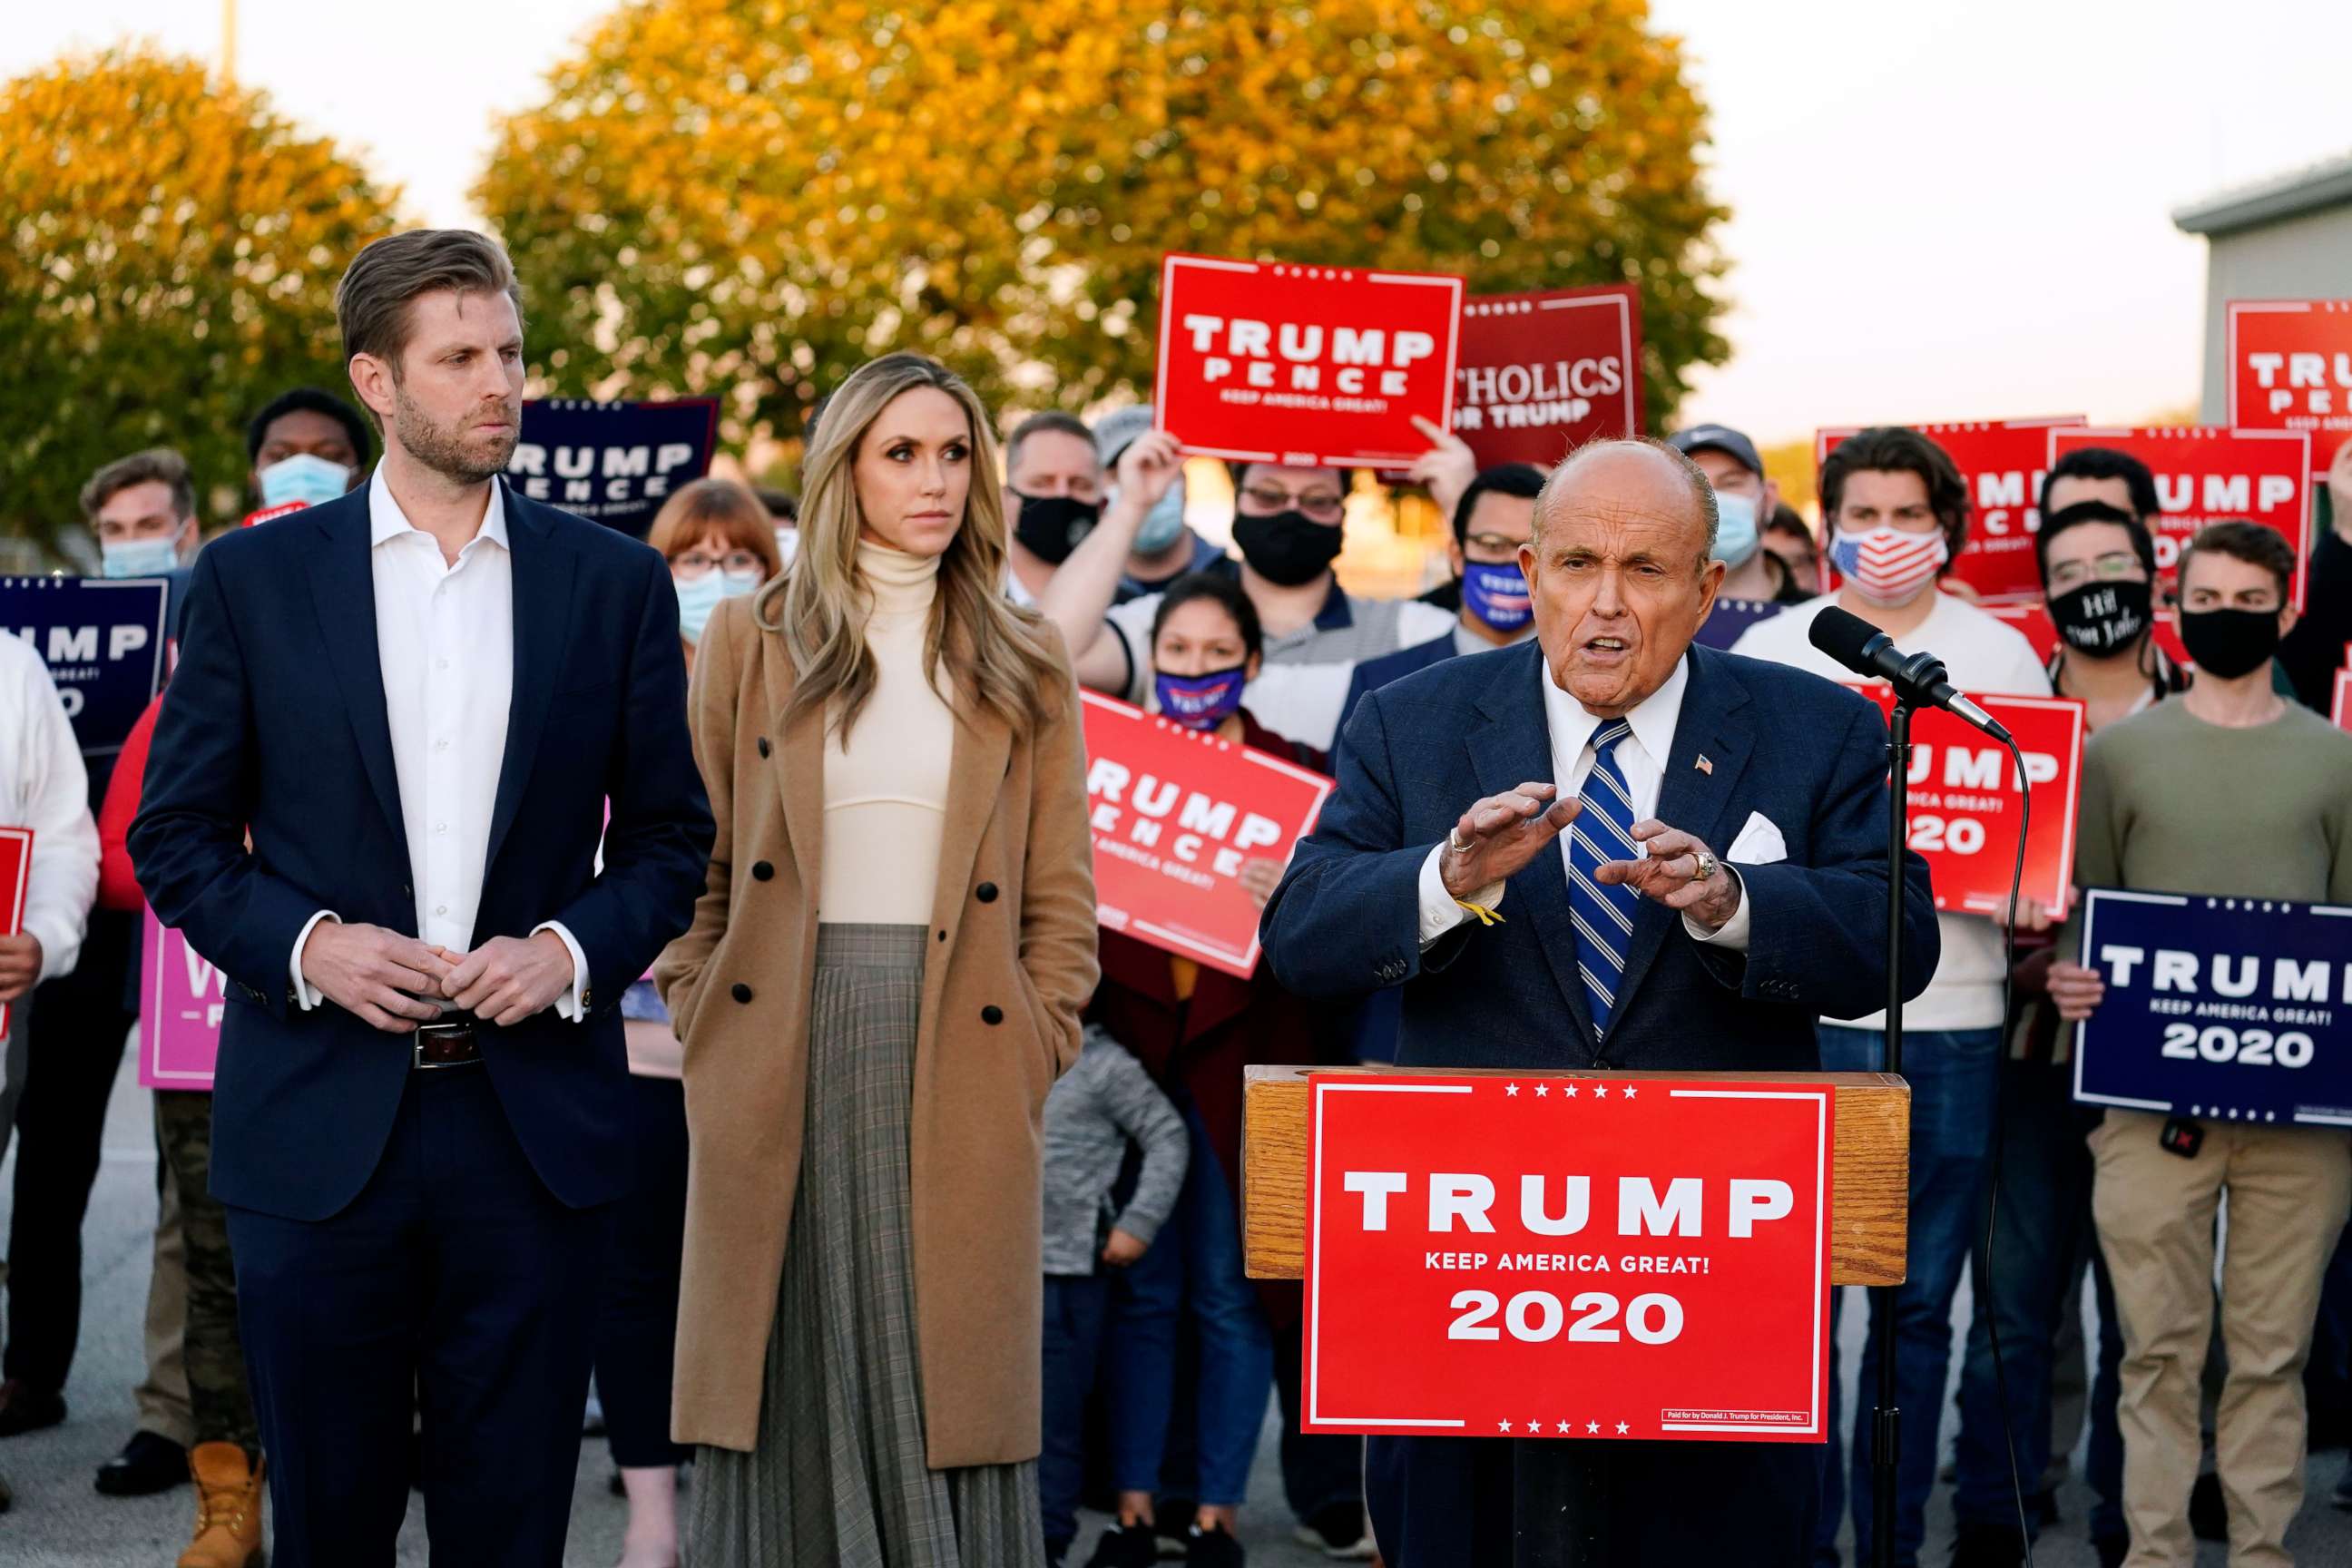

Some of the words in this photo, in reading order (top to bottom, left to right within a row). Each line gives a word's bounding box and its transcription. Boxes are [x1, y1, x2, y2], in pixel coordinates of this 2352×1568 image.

[1183, 314, 1435, 368] TRUMP
[1203, 358, 1407, 397] PENCE
[1488, 398, 1592, 429] TRUMP
[2269, 389, 2352, 415] PE
[502, 473, 670, 502] ENCE
[2153, 474, 2296, 513] UMP
[1087, 757, 1282, 849] RUMP
[1906, 815, 1985, 855] 20
[2101, 944, 2352, 1004] TRUM
[2149, 997, 2192, 1014] KEEP
[2195, 1001, 2269, 1022] AMERICA
[2272, 1007, 2332, 1027] GREAT!
[2161, 1023, 2315, 1069] 2020
[1343, 1171, 1795, 1239] TRUMP
[1426, 1251, 1489, 1270] KEEP
[1497, 1253, 1612, 1273] AMERICA
[1620, 1256, 1710, 1275] GREAT!
[1447, 1289, 1684, 1345] 2020
[1667, 1411, 1681, 1419] Paid
[1682, 1411, 1690, 1419] for
[1691, 1412, 1700, 1420] by
[1730, 1412, 1749, 1421] Trump
[1760, 1413, 1791, 1422] President,
